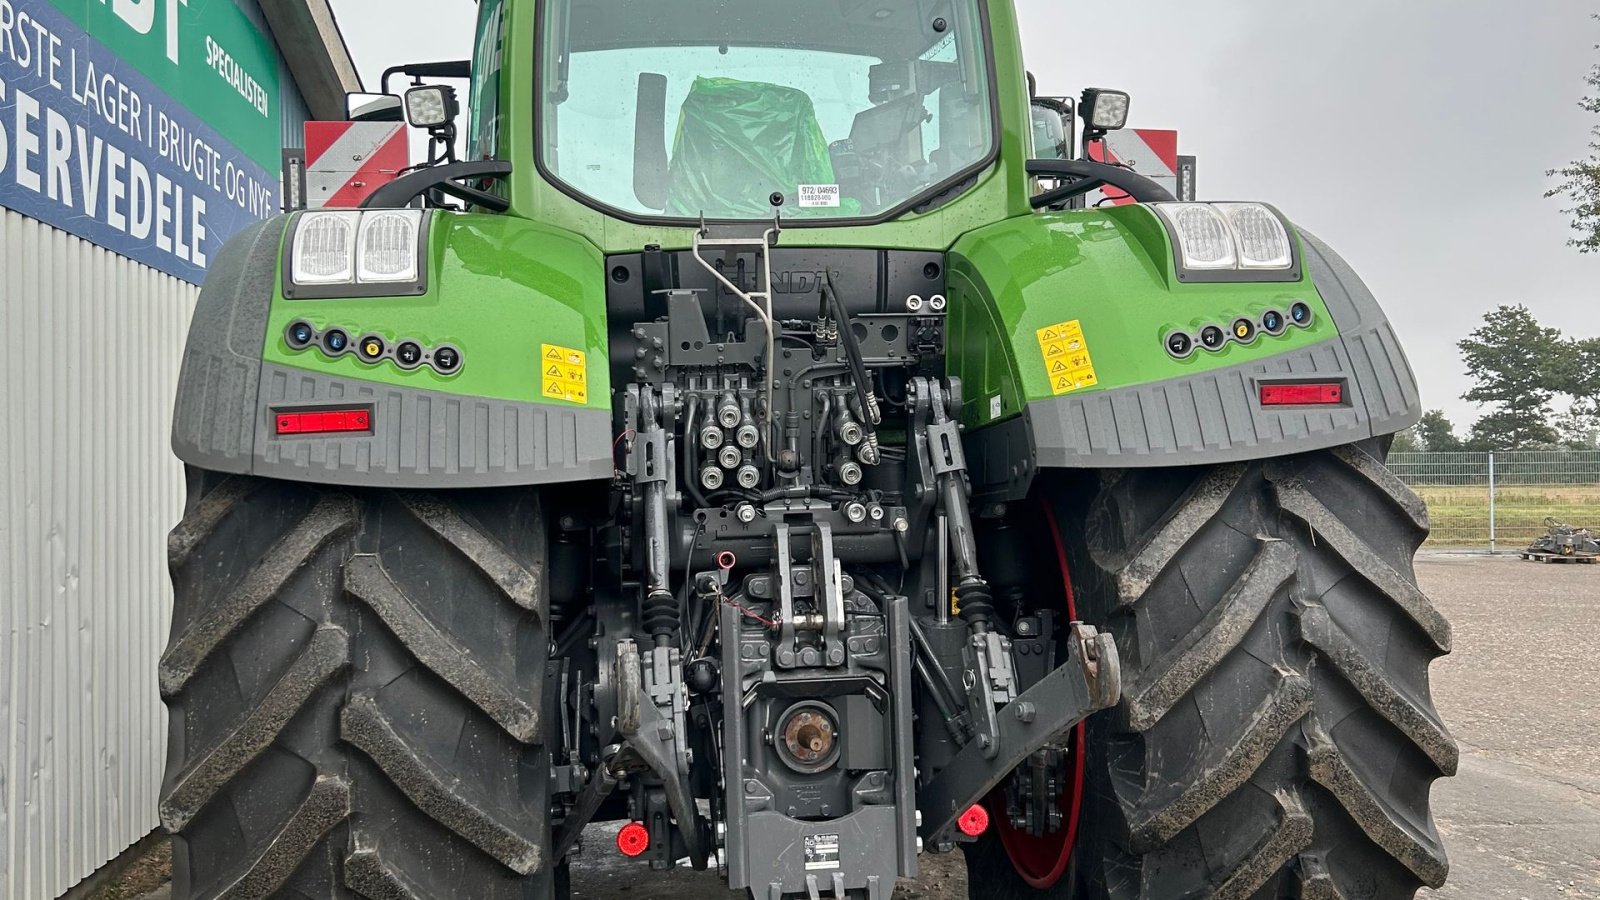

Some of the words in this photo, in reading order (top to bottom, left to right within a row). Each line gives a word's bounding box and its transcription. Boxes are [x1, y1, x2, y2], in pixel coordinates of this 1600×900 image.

[71, 47, 142, 142] LAGER
[148, 103, 153, 148] I
[159, 111, 221, 193] BRUGTE
[225, 160, 245, 208] OG
[205, 34, 268, 118] SPECIALISTEN
[0, 77, 207, 269] ERVEDELE
